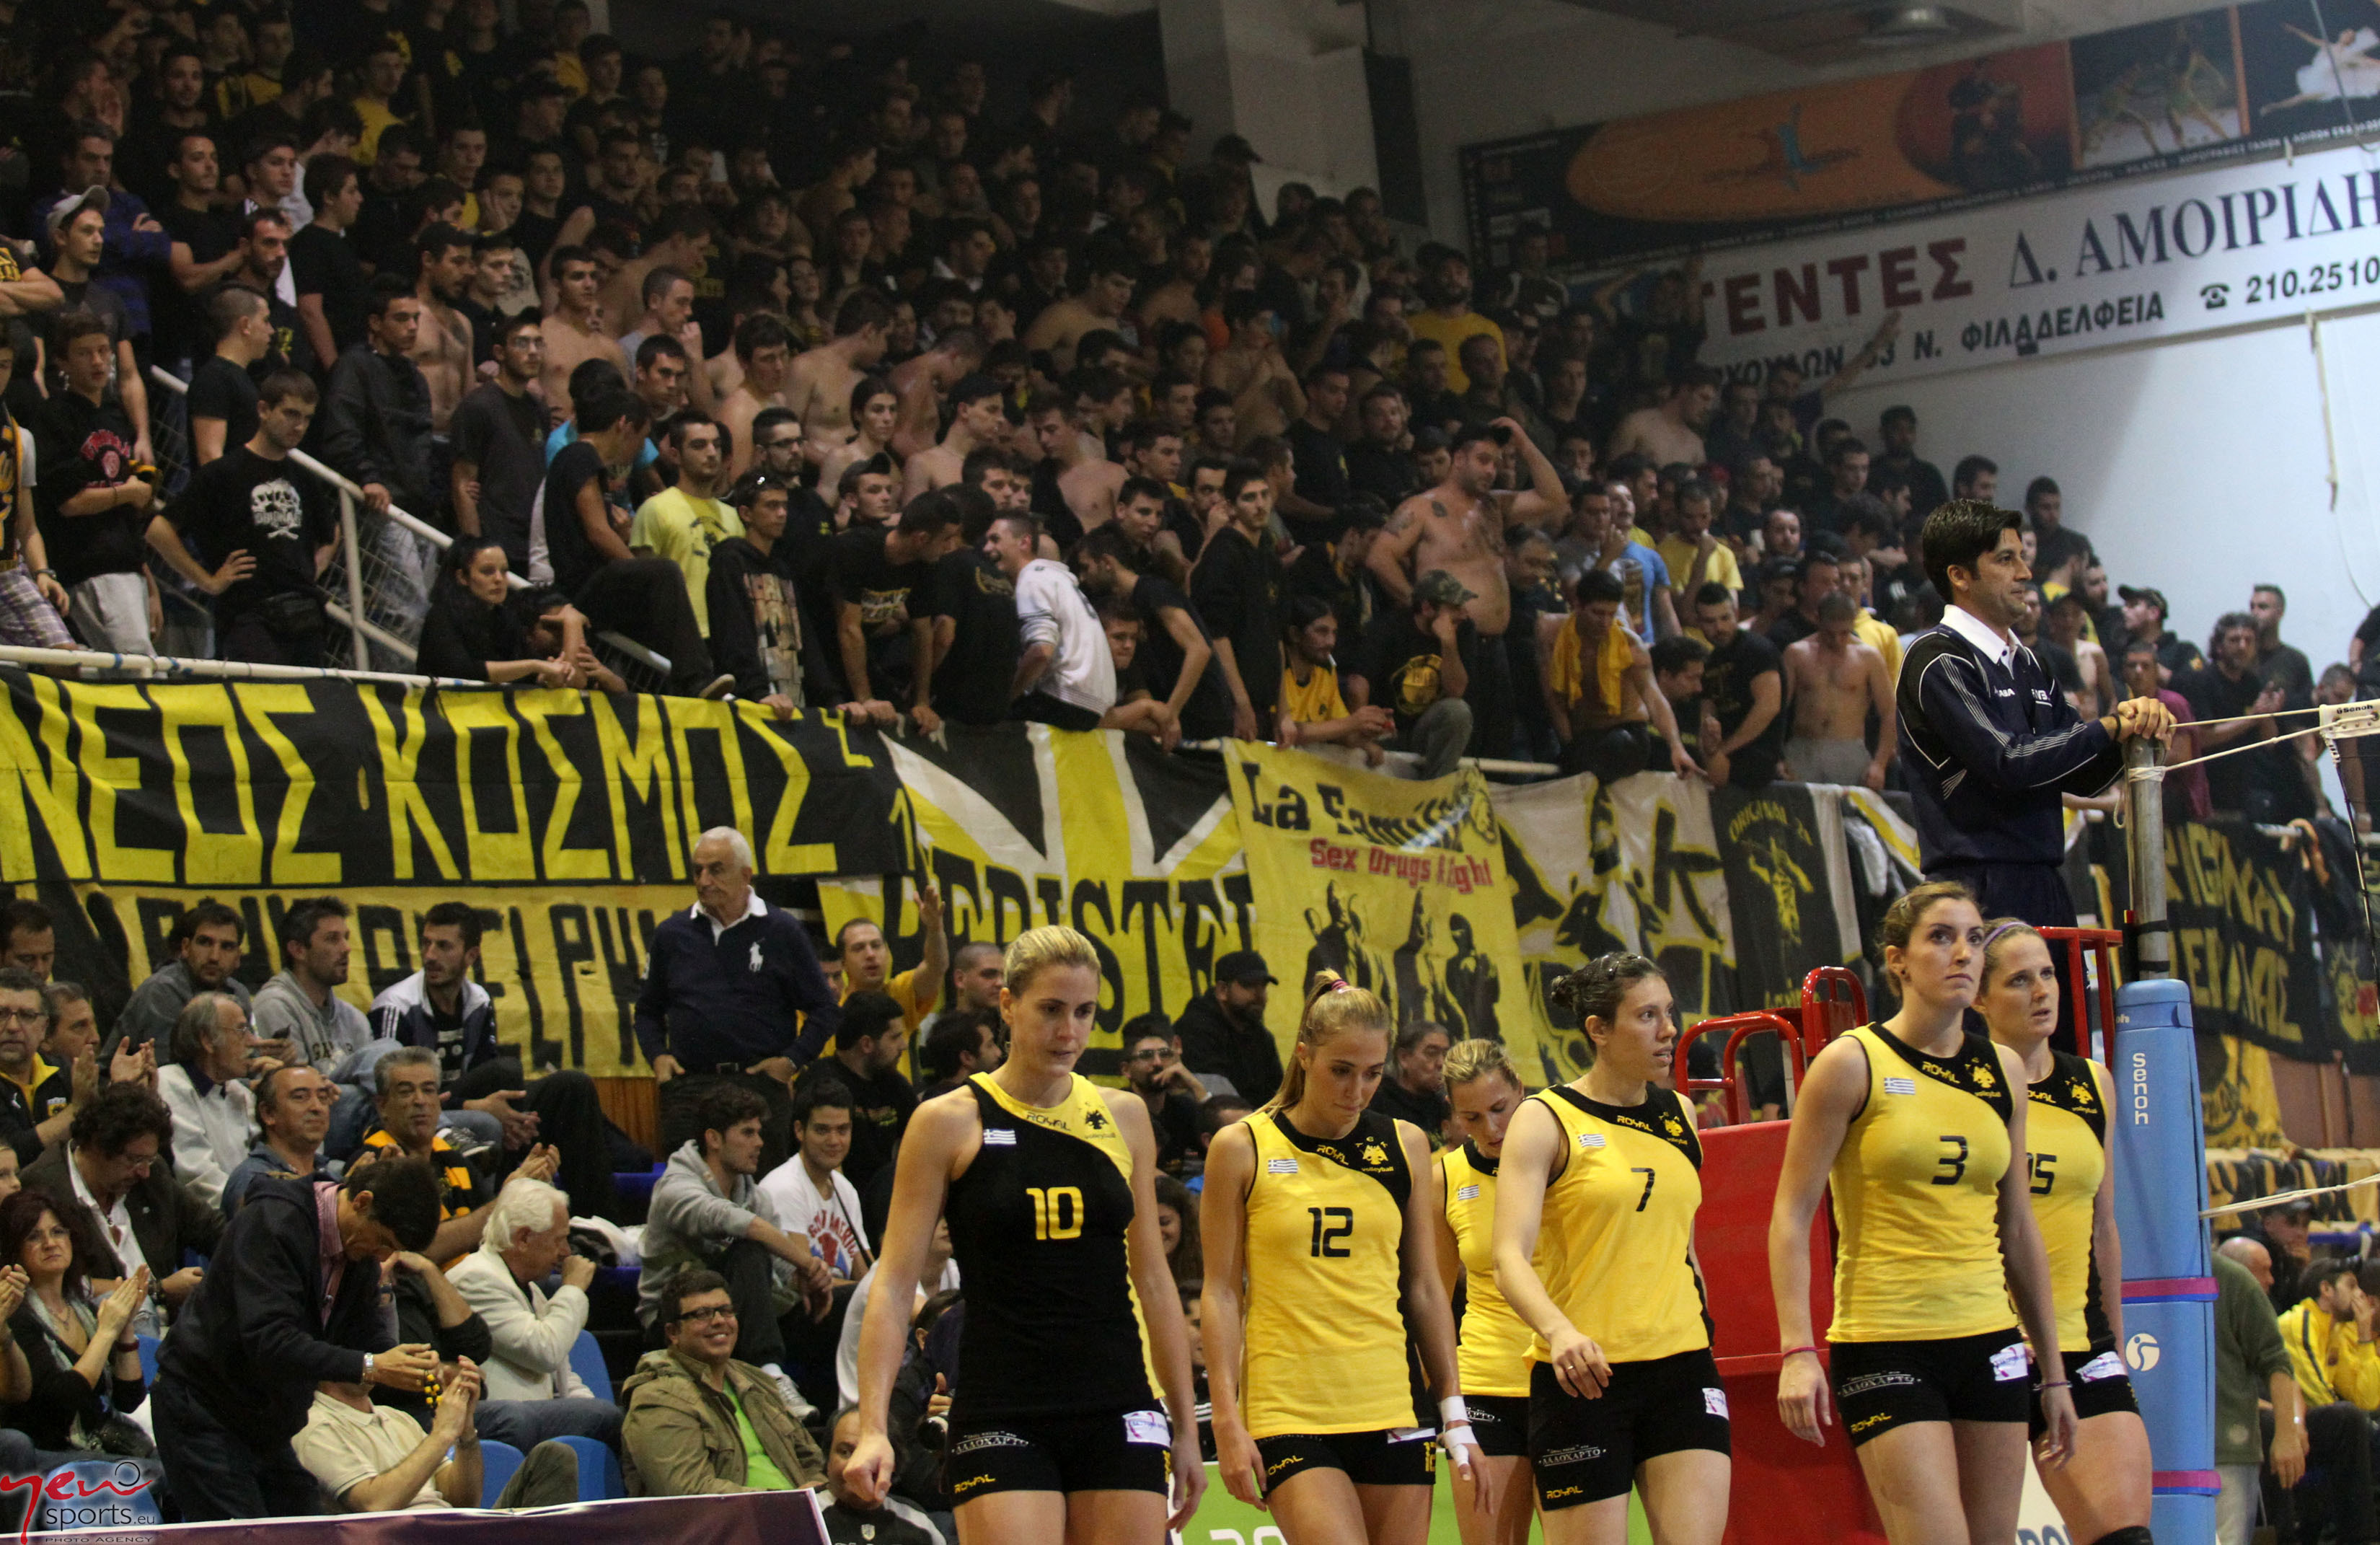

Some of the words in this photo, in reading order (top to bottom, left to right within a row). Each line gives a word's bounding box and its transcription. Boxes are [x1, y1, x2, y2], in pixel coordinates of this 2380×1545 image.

[1702, 238, 1974, 335] ΕΝΤΕΣ
[2009, 231, 2058, 289] Δ.
[2076, 170, 2380, 277] ΑΜΟΙΡΙΔΗ
[1961, 291, 2164, 351] ΦΙΛΑΔΕΛΦΕΙΑ
[2246, 255, 2380, 304] 210.2510
[0, 672, 342, 884] ΝΕΟΣ
[358, 682, 838, 881] ΚΟΣΜΟΣ
[1240, 761, 1311, 831] La
[1310, 837, 1358, 873] Sex
[1367, 845, 1432, 889] Drugs
[2027, 1089, 2057, 1104] OYAL
[1616, 1114, 1654, 1132] ROYAL
[1315, 1144, 1349, 1166] ROYAL
[1931, 1135, 1968, 1186] 3
[1631, 1167, 1656, 1212] 7
[1026, 1186, 1084, 1241] 10
[1308, 1207, 1353, 1257] 12
[1851, 1412, 1892, 1435] ROYAL
[954, 1474, 996, 1495] ROYAL
[1267, 1454, 1304, 1476] OYAL
[1546, 1484, 1584, 1500] ROYAL
